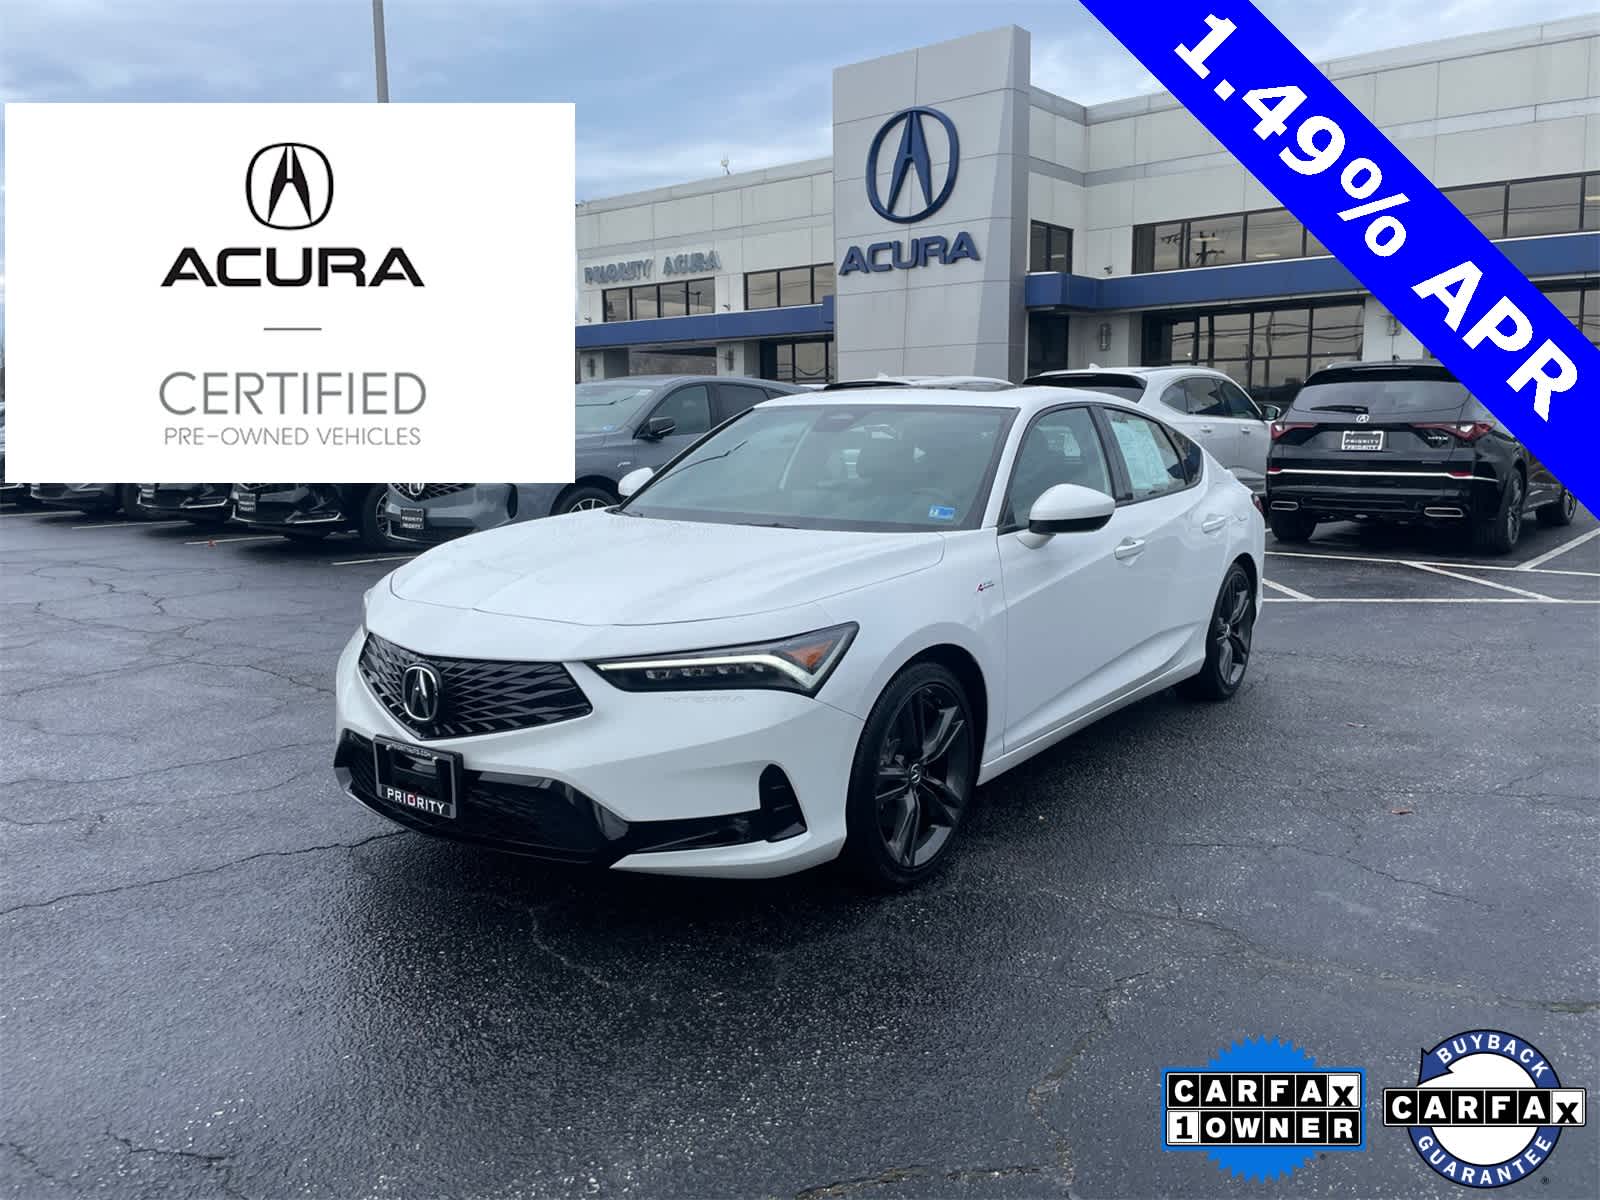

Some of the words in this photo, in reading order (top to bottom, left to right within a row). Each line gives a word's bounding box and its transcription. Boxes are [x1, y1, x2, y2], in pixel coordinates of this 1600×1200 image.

[584, 258, 653, 285] PRIORITY
[663, 250, 722, 277] ACURA
[838, 231, 982, 276] ACURA
[386, 787, 445, 815] PRIORITY
